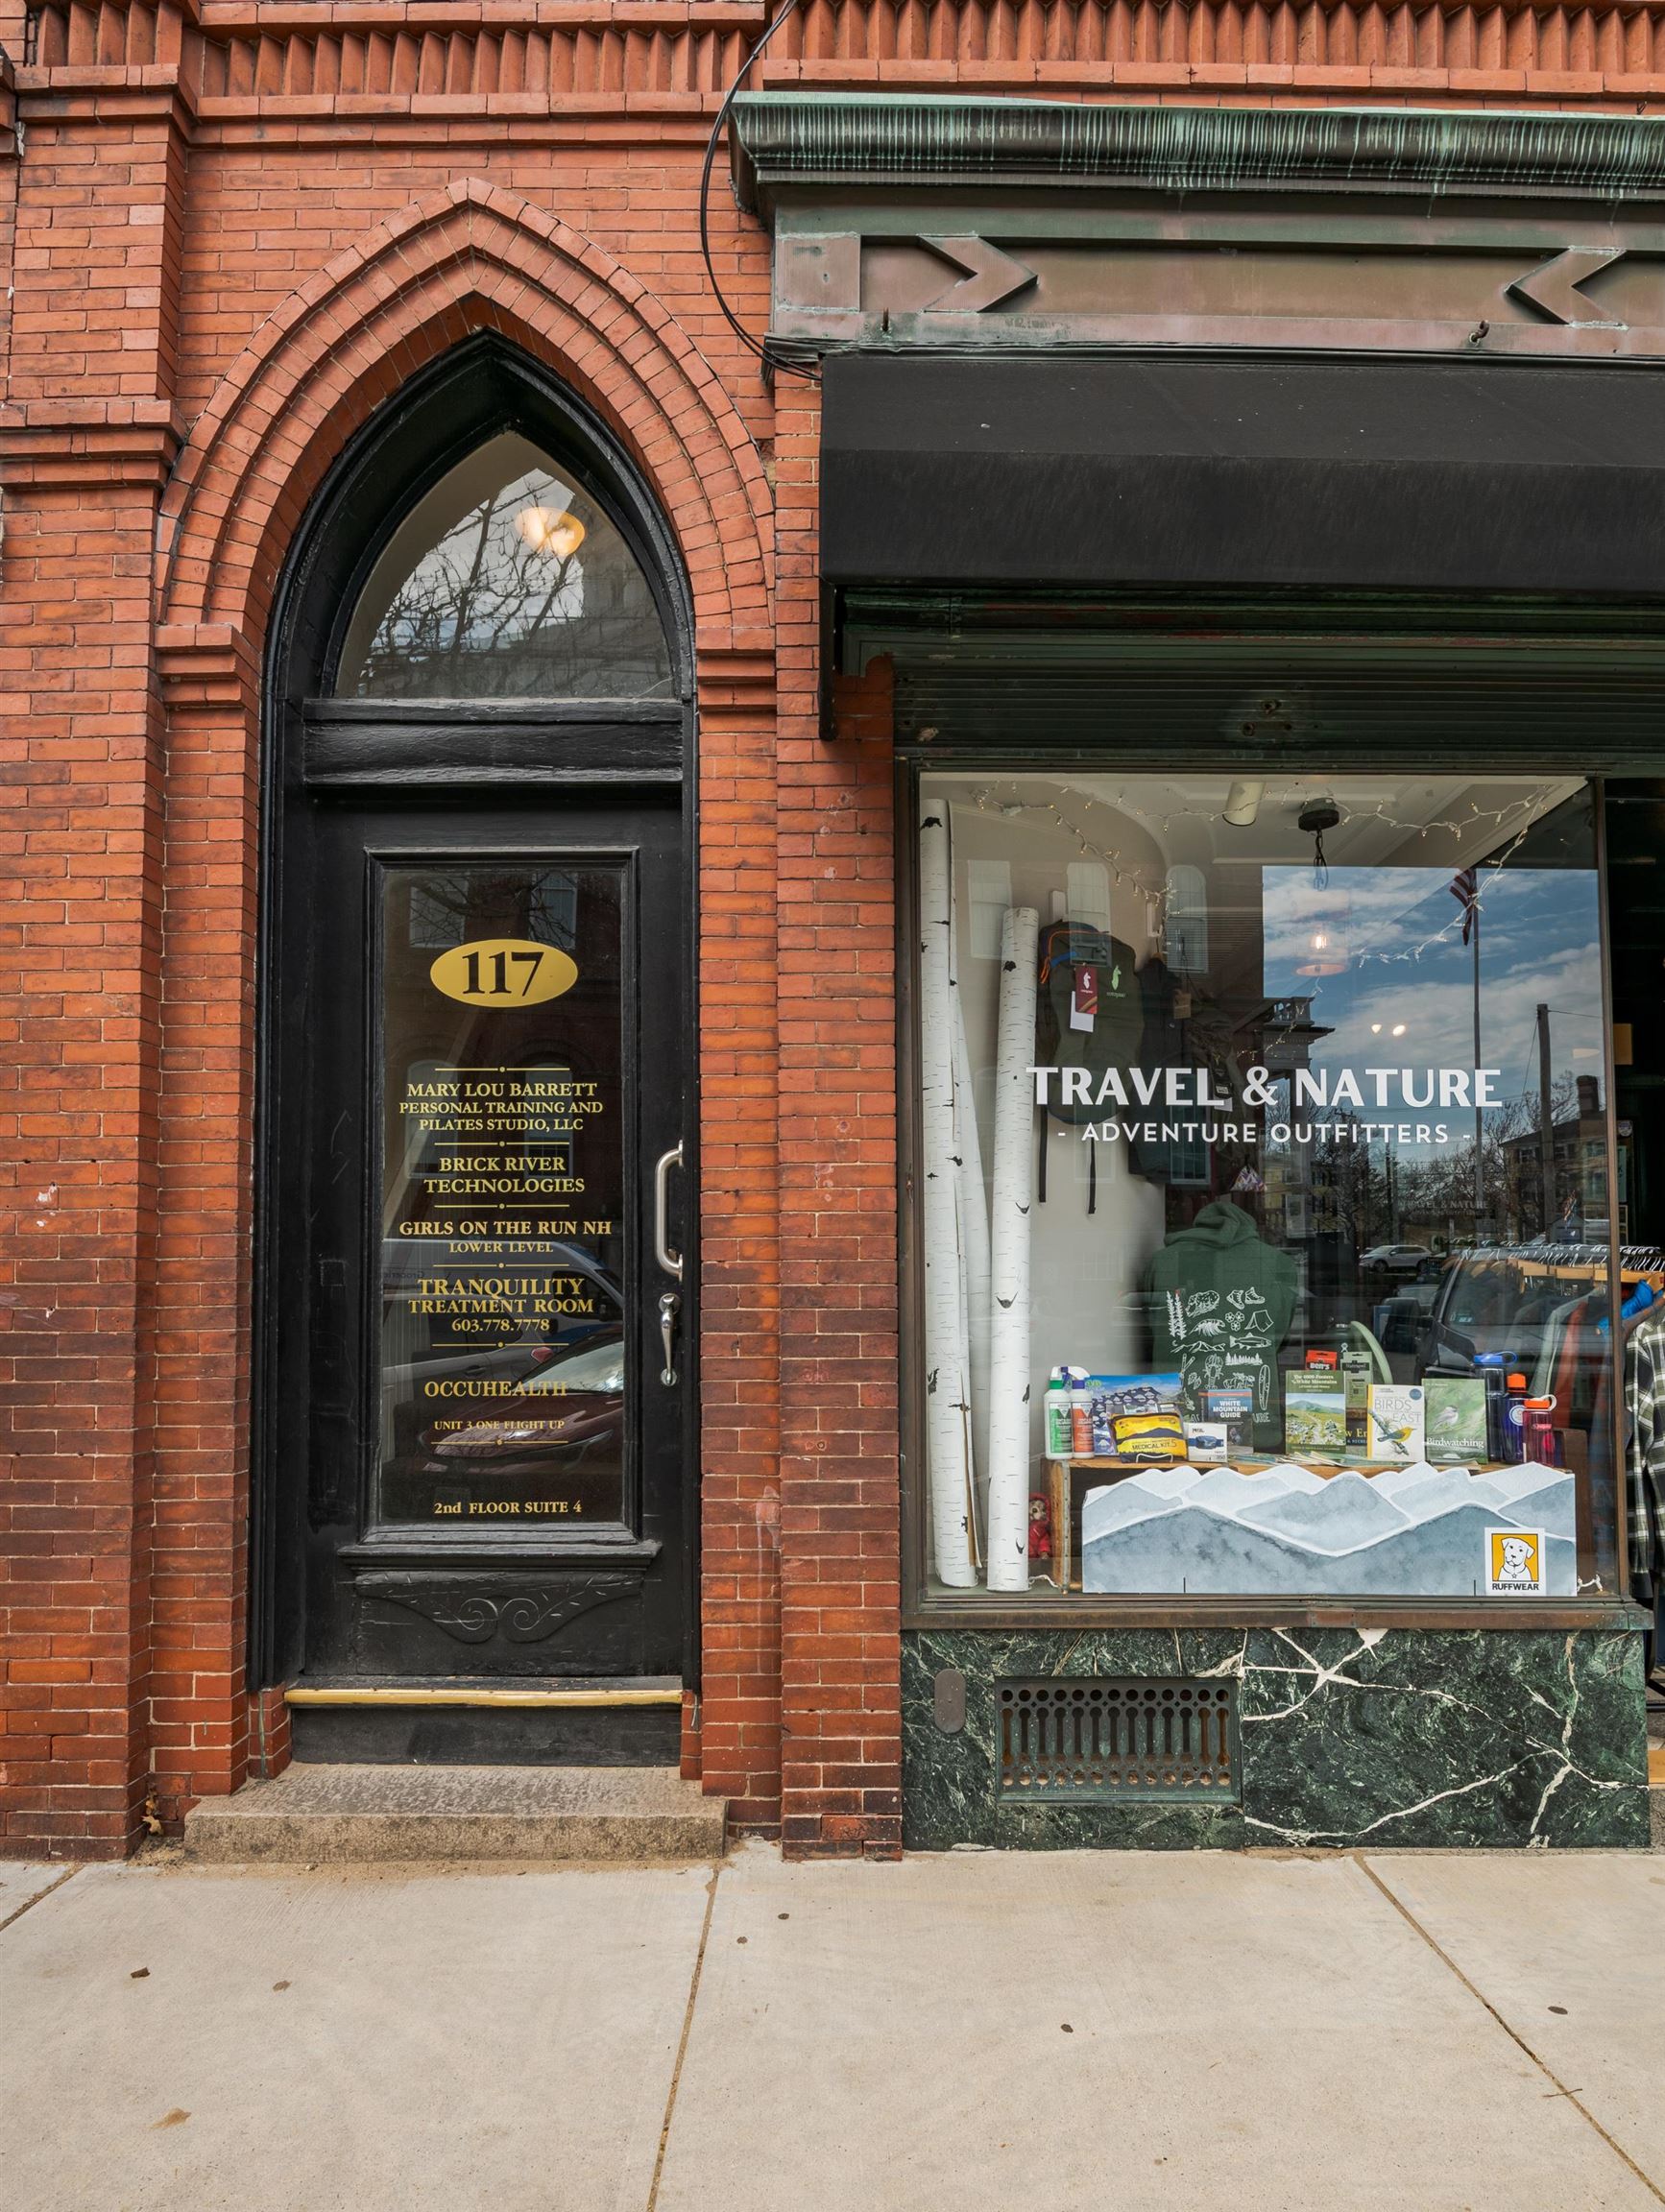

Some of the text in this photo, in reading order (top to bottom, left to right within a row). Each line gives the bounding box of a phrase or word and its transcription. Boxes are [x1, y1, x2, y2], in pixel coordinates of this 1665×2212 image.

[462, 950, 544, 997] 117
[407, 1083, 597, 1097] MARY LOU BARRETT
[1026, 1066, 1503, 1108] TRAVEL & NATURE
[399, 1102, 603, 1115] PERSONAL TRAINING AND
[419, 1118, 584, 1134] PILATES STUDIO, LLC
[1081, 1123, 1256, 1143] ADVENTURE
[1270, 1123, 1448, 1143] OUTFITTERS
[439, 1157, 566, 1172] BRICK RIVER
[423, 1178, 585, 1193] TECHNOLOGIES
[399, 1221, 612, 1236] GIRLS ON THE RUN NH
[449, 1241, 554, 1253] LOWER LEVEL
[418, 1278, 585, 1299] TRANQUILITY
[408, 1299, 594, 1314] TREATMENT ROOM
[451, 1318, 550, 1333] 603.778.7778
[424, 1381, 567, 1397] OCCUHEALTH
[1374, 1399, 1412, 1411] BIRDS
[434, 1420, 566, 1431] UNIT 3 ONE FLIGHT UP
[1392, 1413, 1422, 1424] EAST
[1426, 1437, 1484, 1449] Birdwatching
[434, 1500, 582, 1514] 2nd FLOOR SUITE 4
